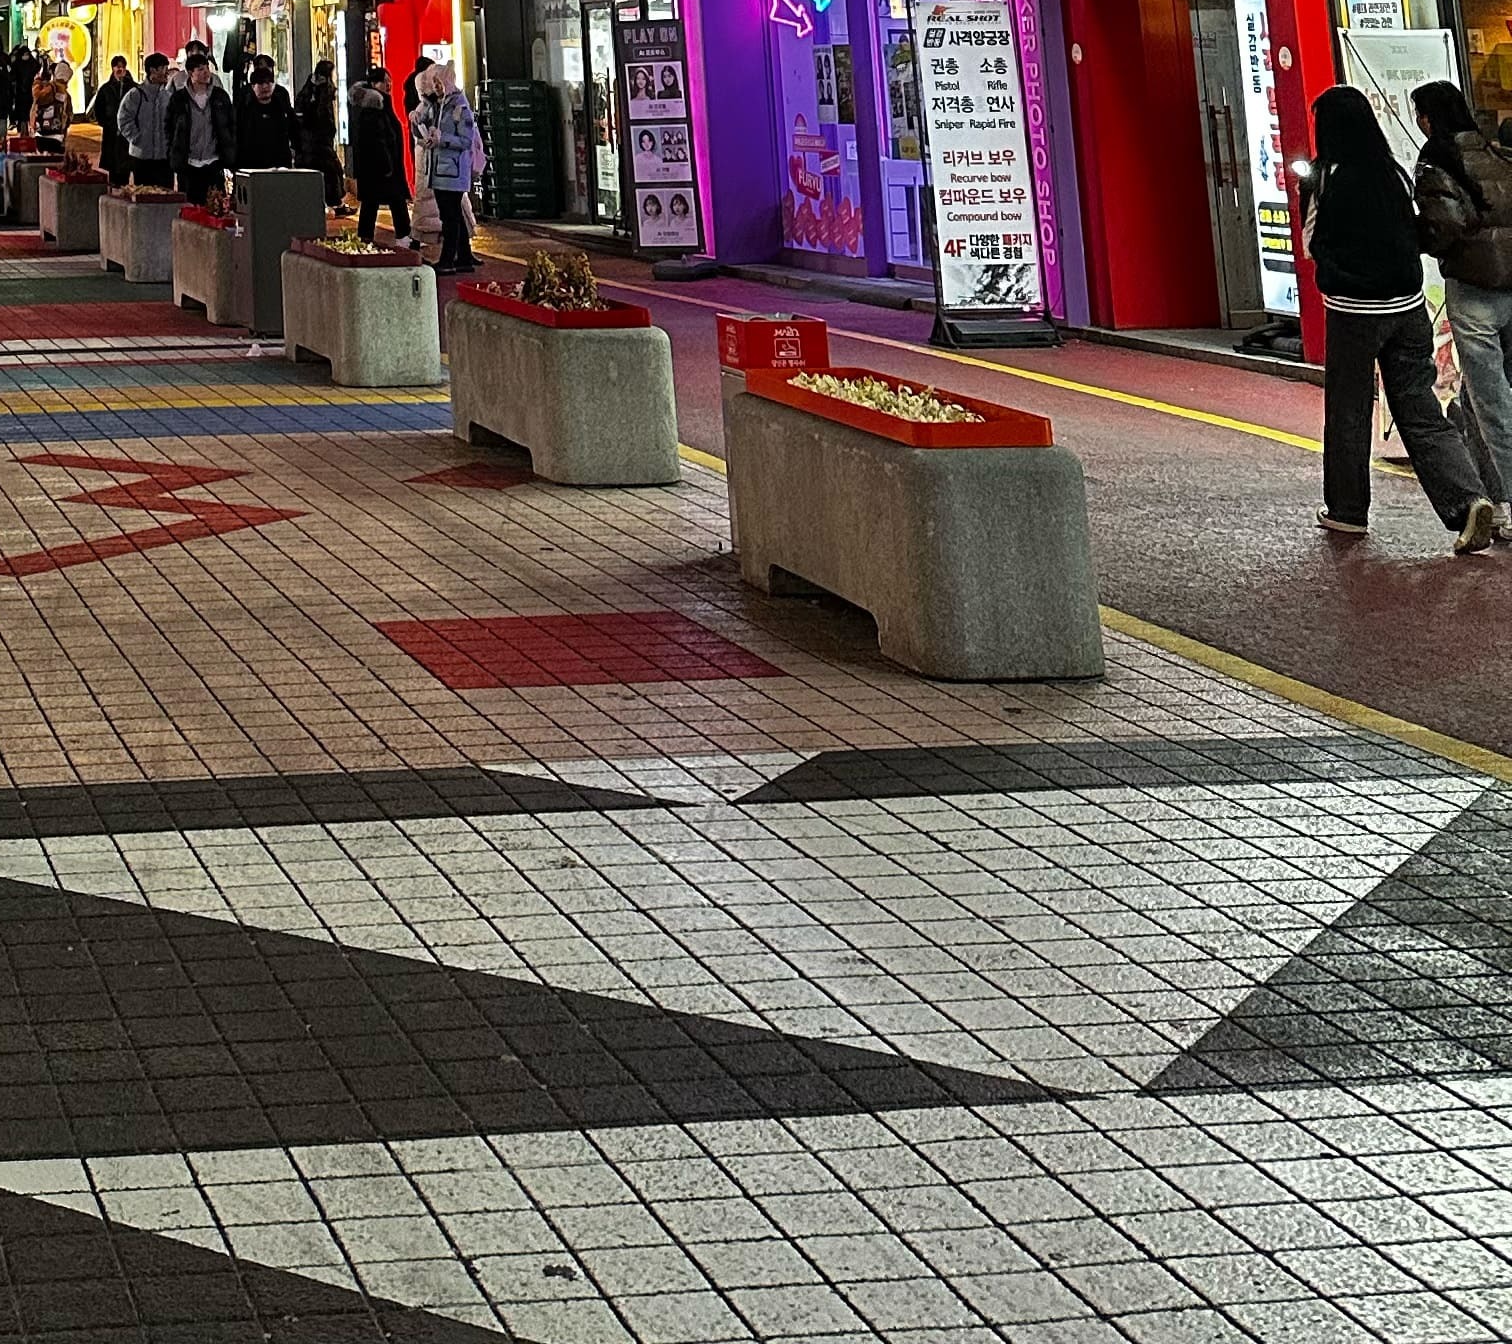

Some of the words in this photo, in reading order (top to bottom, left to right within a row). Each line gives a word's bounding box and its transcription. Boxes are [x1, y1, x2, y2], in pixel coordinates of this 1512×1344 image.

[967, 14, 1001, 22] SHOT
[623, 27, 656, 44] PLAY
[948, 30, 1011, 46] 사격양궁장
[930, 57, 960, 75] 권총
[979, 57, 1008, 75] 소총
[934, 80, 961, 91] Pistol
[987, 79, 1008, 91] Rifle
[931, 95, 975, 114] 저격총
[986, 95, 1016, 113] 연사
[1026, 61, 1048, 170] PHOTO
[934, 119, 965, 131] Sniper
[969, 118, 997, 131] Rapid
[998, 118, 1016, 129] Fire
[942, 149, 985, 167] 리커브
[988, 149, 1017, 167] 보우
[950, 172, 989, 184] Recurve
[990, 171, 1012, 183] bow
[938, 188, 996, 206] 컴파운드
[998, 187, 1027, 205] 보우
[946, 210, 999, 223] Compound
[1001, 210, 1023, 221] bow
[1036, 181, 1057, 269] SHOP
[943, 238, 967, 258] 4F
[969, 233, 1000, 247] 다양한
